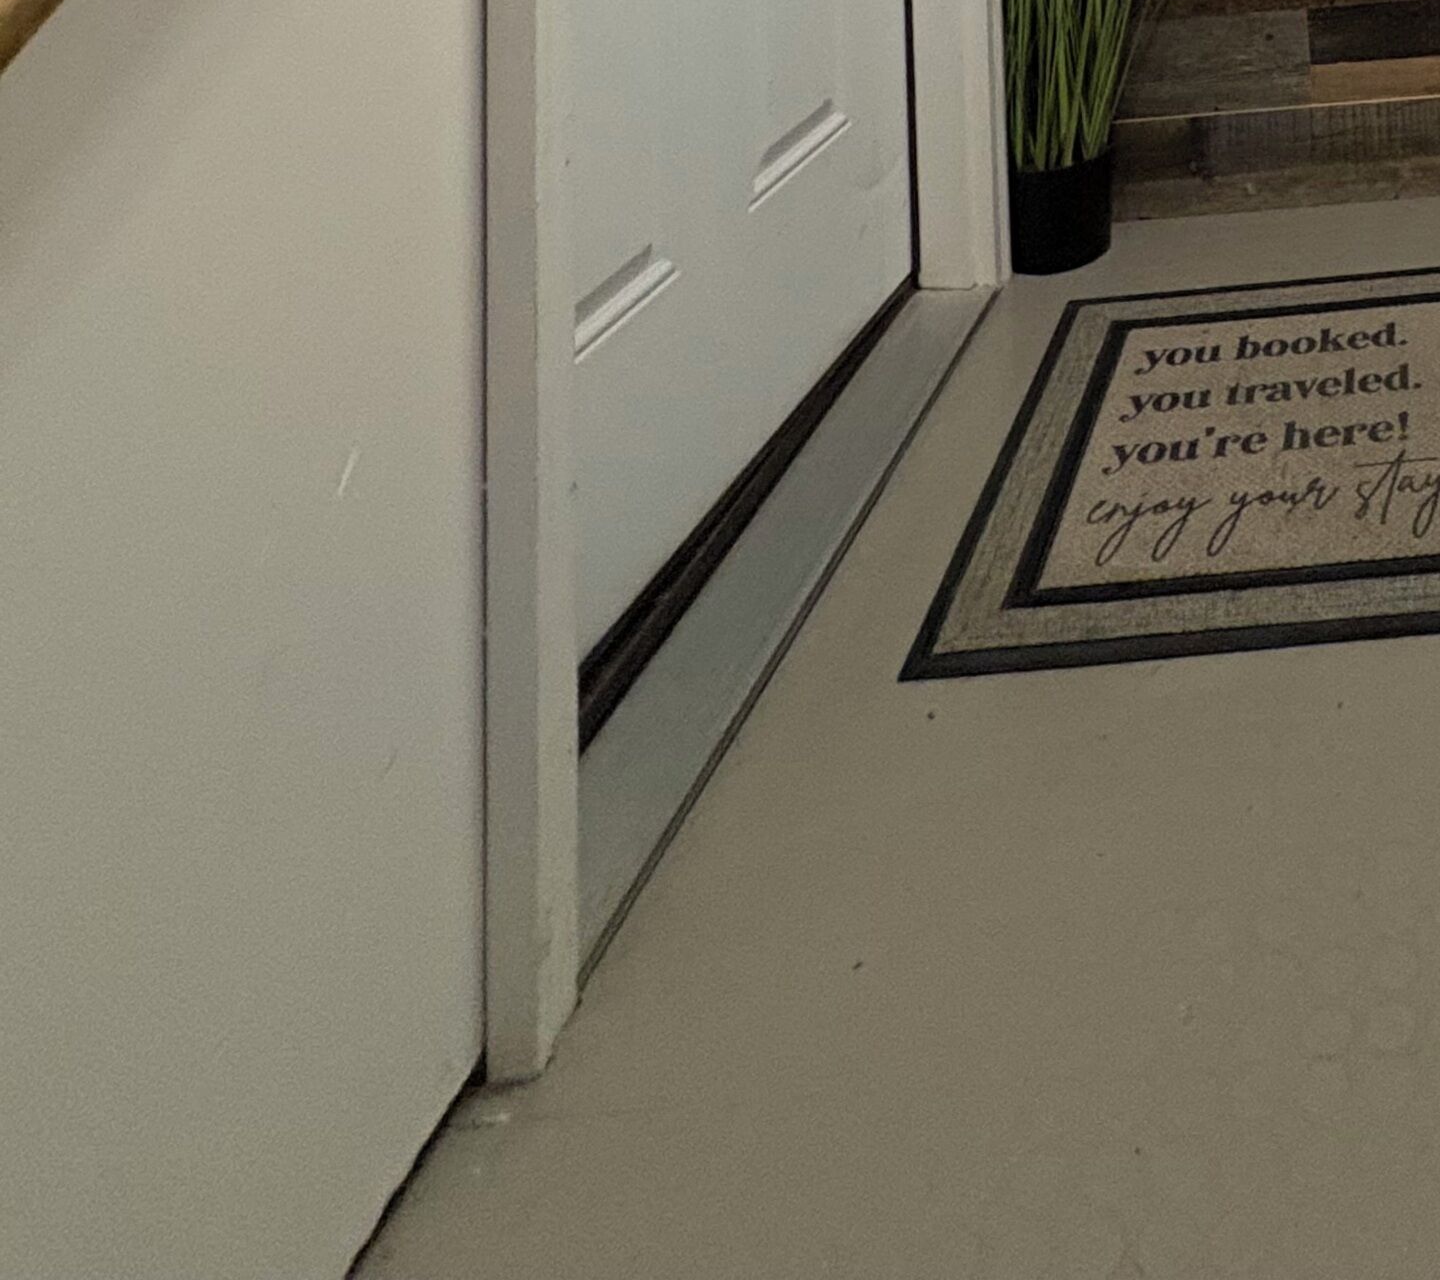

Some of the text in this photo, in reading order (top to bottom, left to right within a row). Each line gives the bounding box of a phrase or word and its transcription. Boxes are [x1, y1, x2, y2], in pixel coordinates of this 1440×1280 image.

[1133, 321, 1408, 375] you booked.
[1118, 363, 1422, 422] you traveled.
[1102, 411, 1410, 476] you're here!
[1087, 495, 1211, 567] enjoy
[1206, 476, 1339, 557] your
